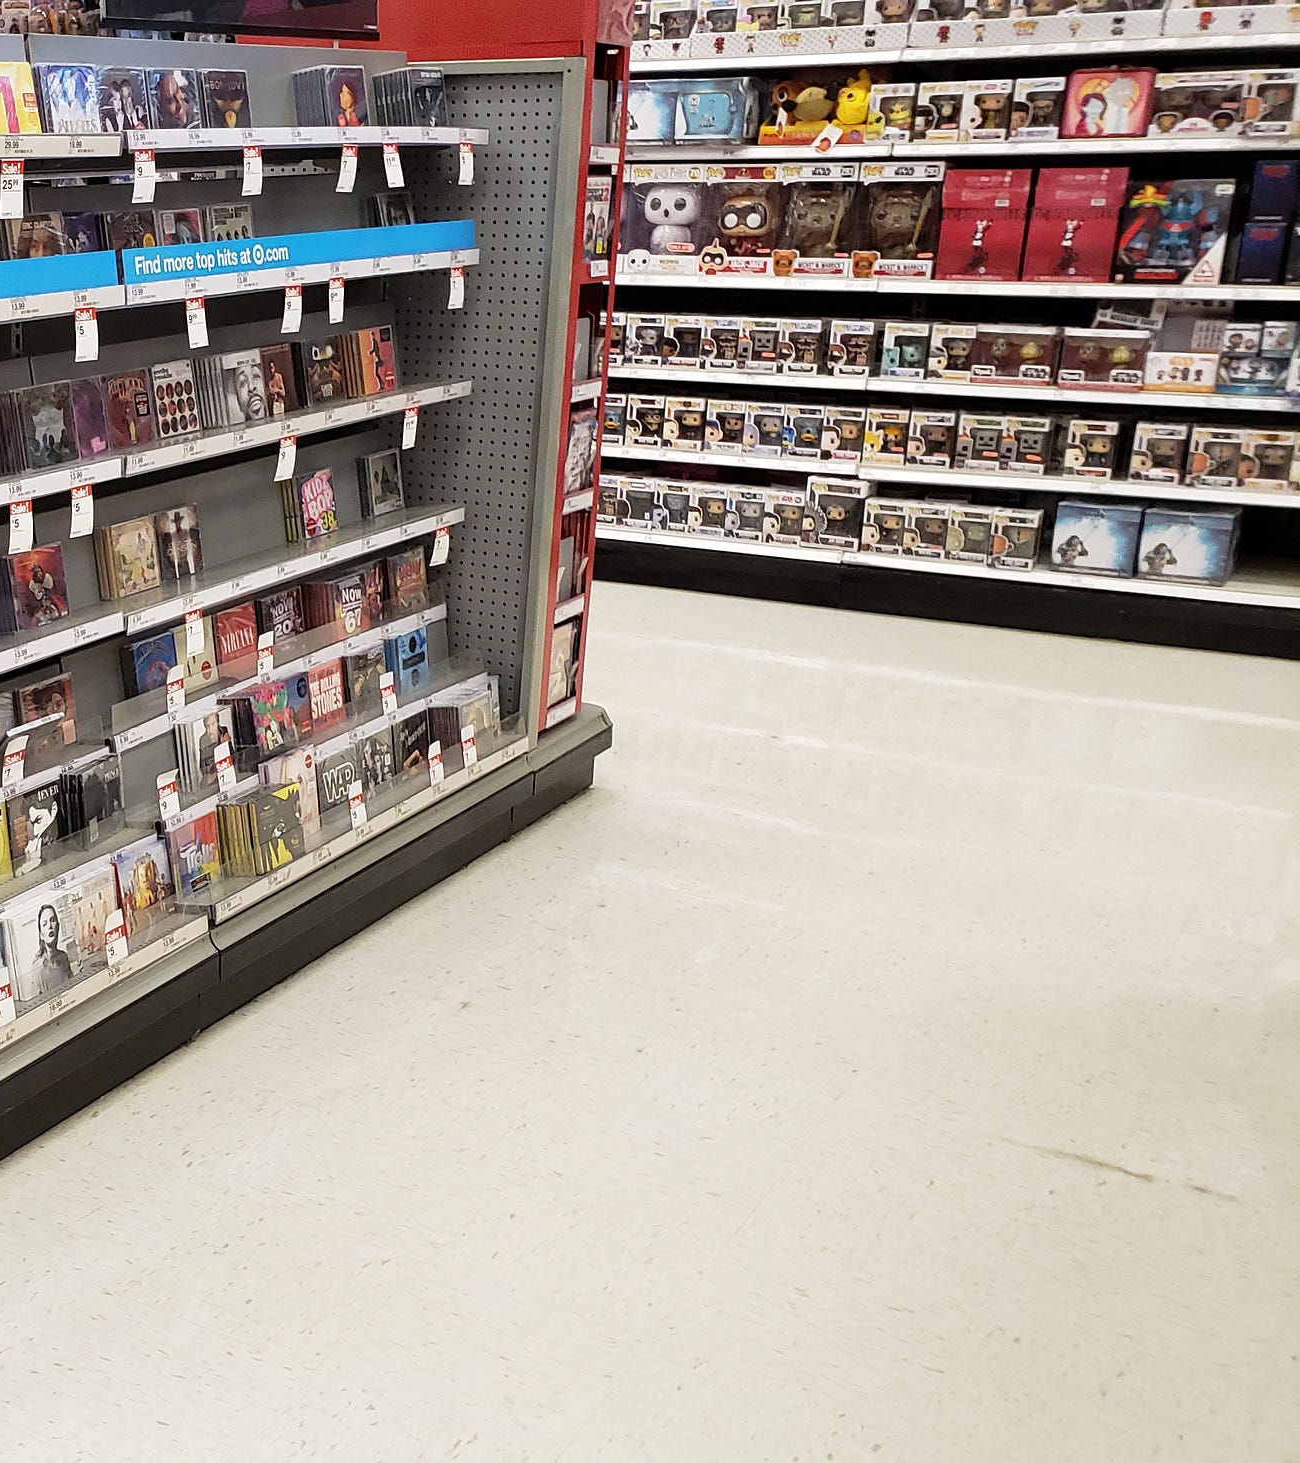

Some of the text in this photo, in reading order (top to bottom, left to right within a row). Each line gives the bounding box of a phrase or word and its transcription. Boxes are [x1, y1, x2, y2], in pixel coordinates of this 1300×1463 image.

[4, 140, 20, 150] 29.99
[134, 150, 153, 162] Sale!
[1, 162, 21, 174] Sale!
[134, 257, 160, 276] Find
[163, 253, 194, 273] more
[195, 251, 216, 272] top
[216, 248, 238, 268] hits
[238, 252, 251, 266] at
[11, 301, 26, 312] 13.99
[75, 309, 94, 321] Sale!
[8, 484, 23, 495] 13.99
[71, 486, 89, 500] Sale!
[301, 473, 331, 500] KIDZ
[10, 500, 29, 515] Sale!
[306, 491, 334, 519] BOP
[320, 510, 336, 531] 38
[342, 588, 362, 603] NOW
[270, 597, 295, 619] NOW
[274, 618, 292, 638] 20
[343, 609, 363, 634] 67
[219, 626, 255, 656] NIRVANA
[311, 685, 343, 720] STONES
[5, 752, 23, 766] Sale!
[215, 758, 233, 775] Sale!
[2, 785, 17, 798] 13.99
[158, 780, 176, 798] Sale!
[105, 928, 123, 944] Sale!
